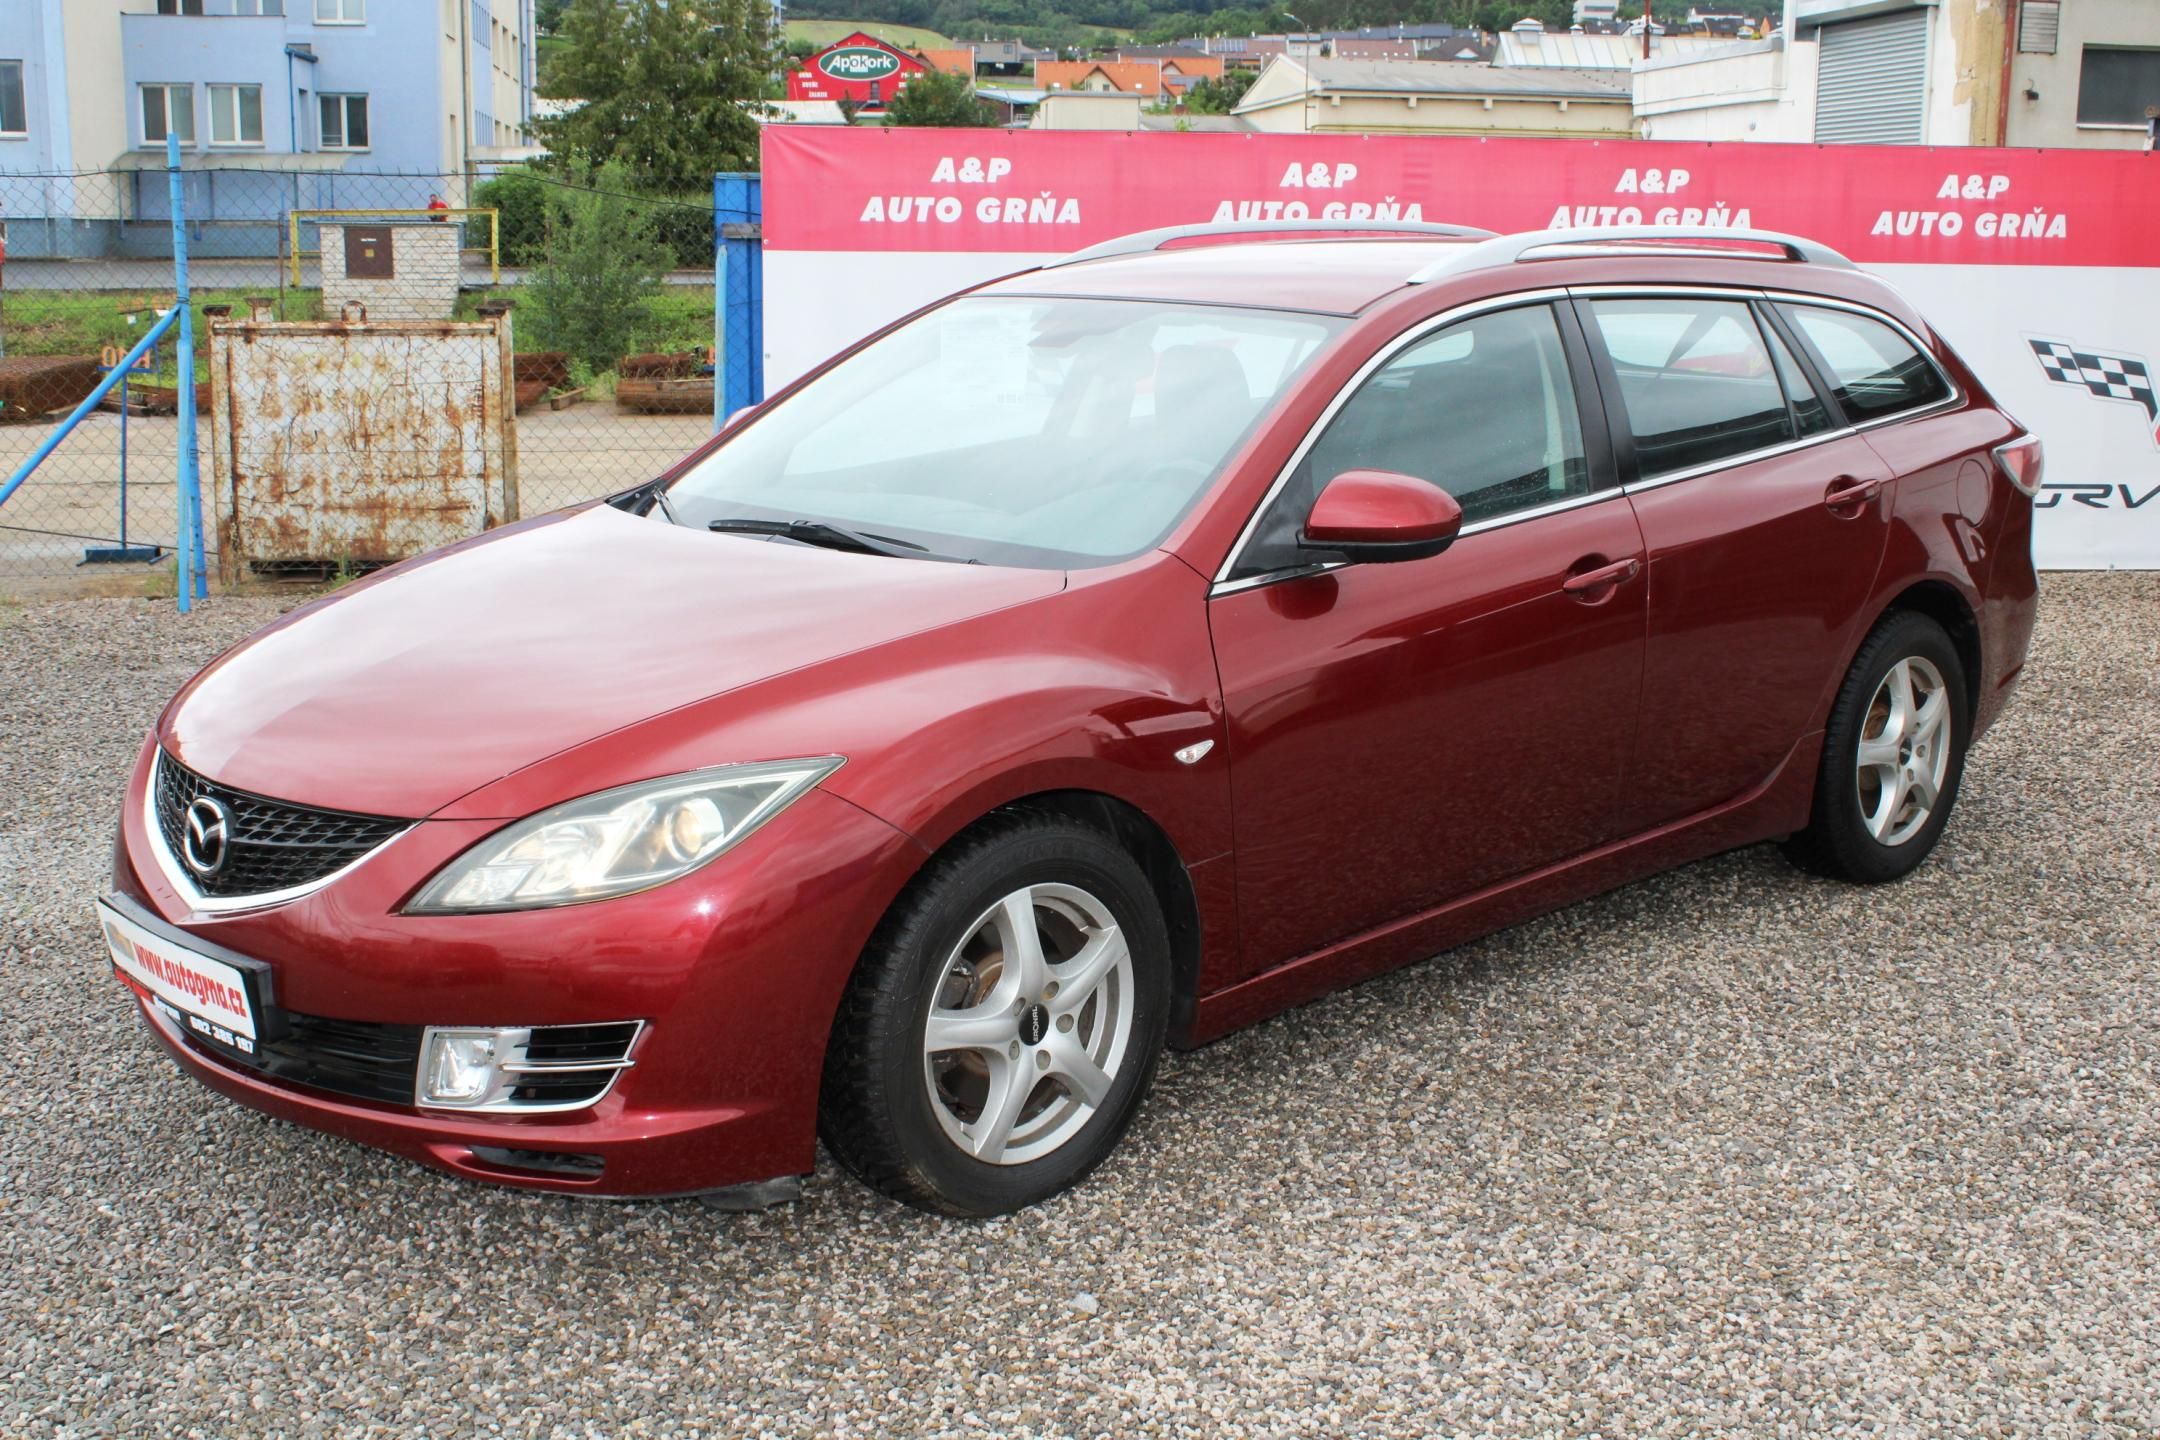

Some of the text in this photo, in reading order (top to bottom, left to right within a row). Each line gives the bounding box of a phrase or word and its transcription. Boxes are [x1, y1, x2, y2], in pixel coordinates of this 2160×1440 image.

[931, 157, 1011, 183] A&P
[1280, 162, 1357, 188] A&P
[1614, 168, 1690, 193] A&P
[1936, 174, 2010, 199] A&P
[860, 191, 1080, 223] AUTO GRŇA
[1211, 196, 1423, 223] AUTO GRŇA
[1547, 201, 1751, 229] AUTO GRŇA
[1870, 207, 2067, 238] AUTO GRŇA
